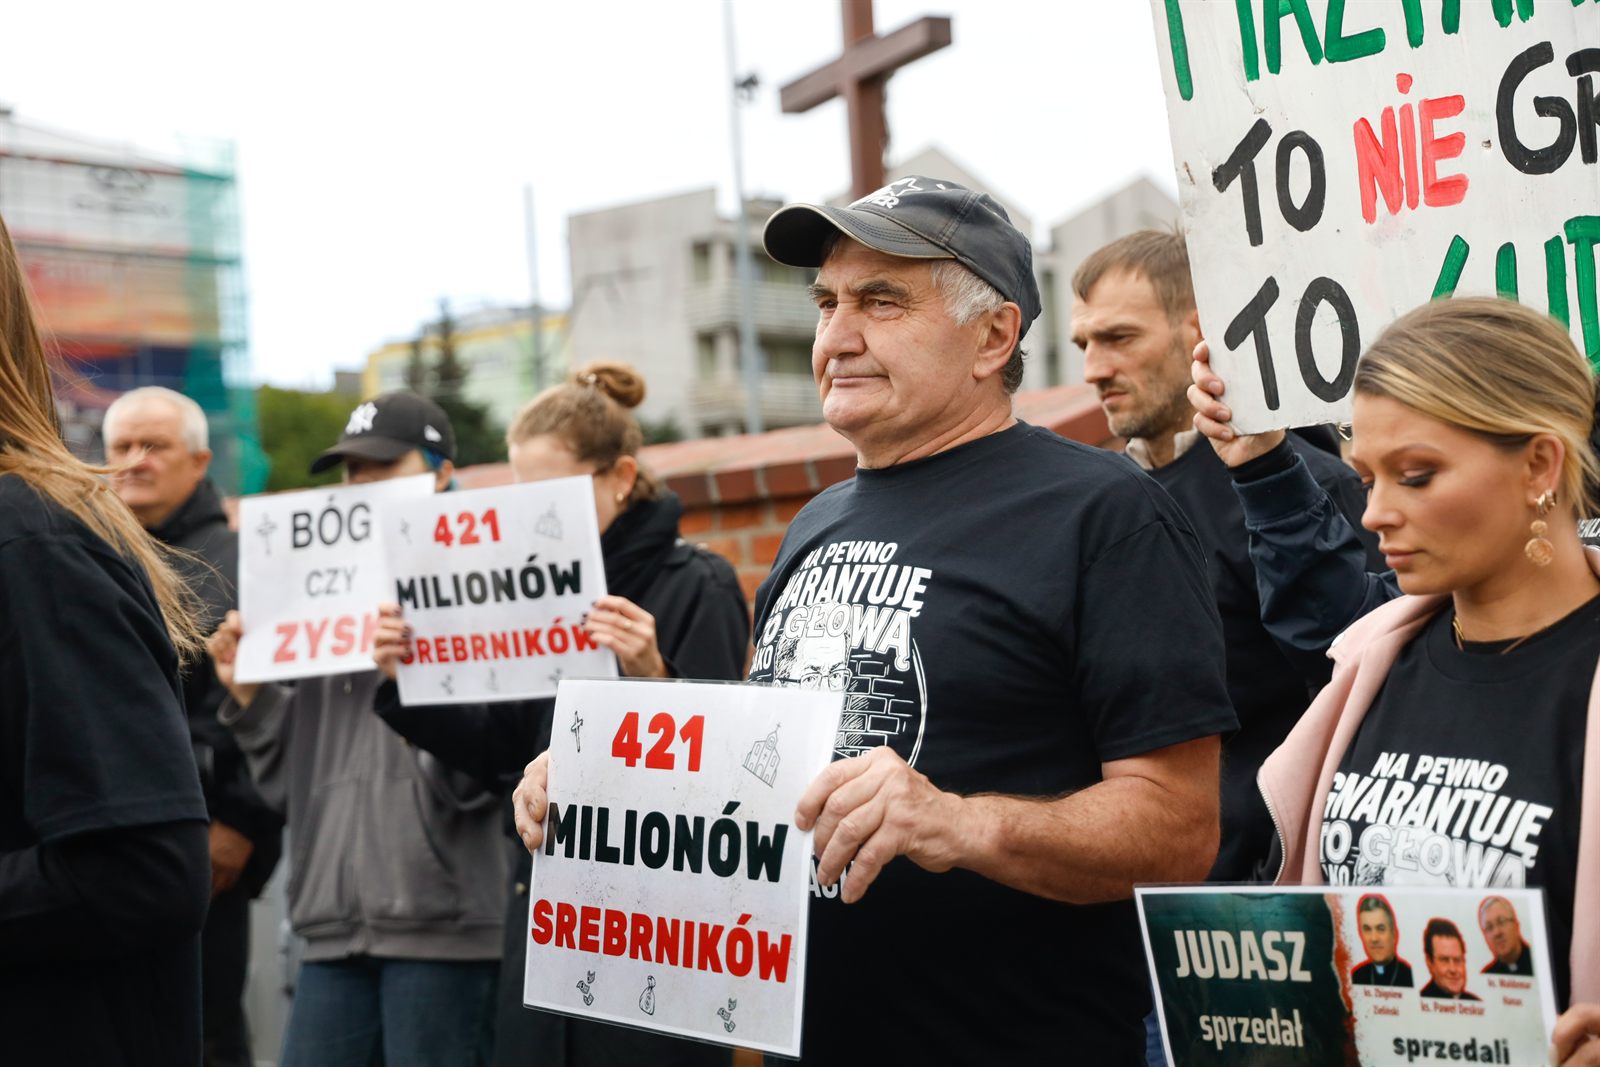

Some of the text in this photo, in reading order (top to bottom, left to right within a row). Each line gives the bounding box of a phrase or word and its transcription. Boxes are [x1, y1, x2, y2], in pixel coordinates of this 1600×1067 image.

[1212, 118, 1327, 247] TO
[1353, 73, 1470, 224] NIE
[1224, 276, 1361, 411] TO
[291, 494, 372, 549] BÓG
[433, 507, 502, 548] 421
[821, 541, 898, 565] PEWNO
[306, 566, 357, 598] CZY
[396, 553, 583, 611] MILIONÓW
[784, 602, 912, 672] GŁOWĄ
[611, 711, 705, 773] 421
[1370, 752, 1509, 792] NA PEWNO
[544, 800, 789, 883] MILIONÓW
[531, 898, 793, 983] SREBRNIKÓW
[1174, 929, 1312, 983] JUDASZ
[1200, 1008, 1304, 1050] sprzedał
[1393, 1035, 1511, 1066] sprzedali
